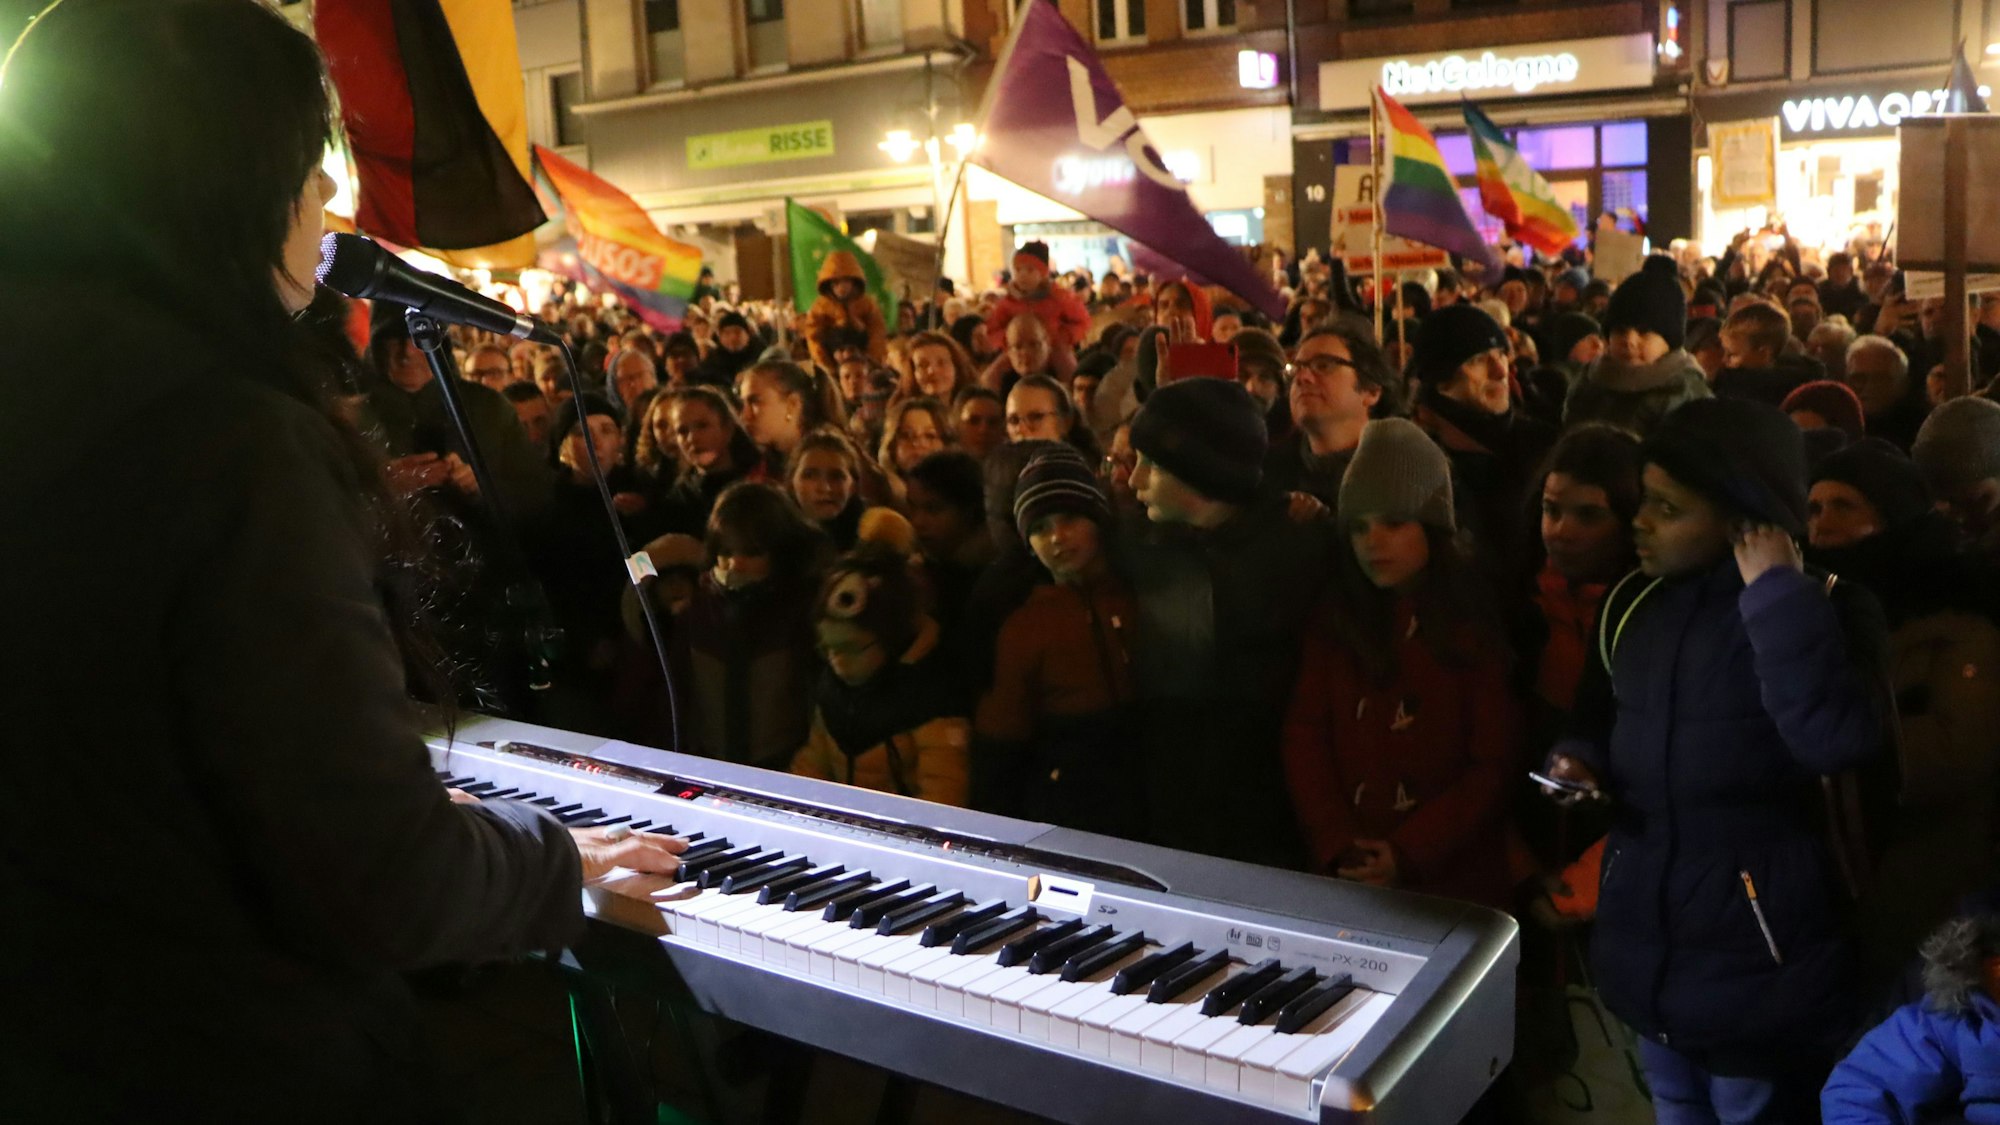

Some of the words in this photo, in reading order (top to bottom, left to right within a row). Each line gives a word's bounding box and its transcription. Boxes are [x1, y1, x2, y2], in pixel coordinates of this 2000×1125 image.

[769, 127, 827, 152] RISSE
[1306, 184, 1325, 202] 10
[1332, 952, 1388, 973] PX-200
